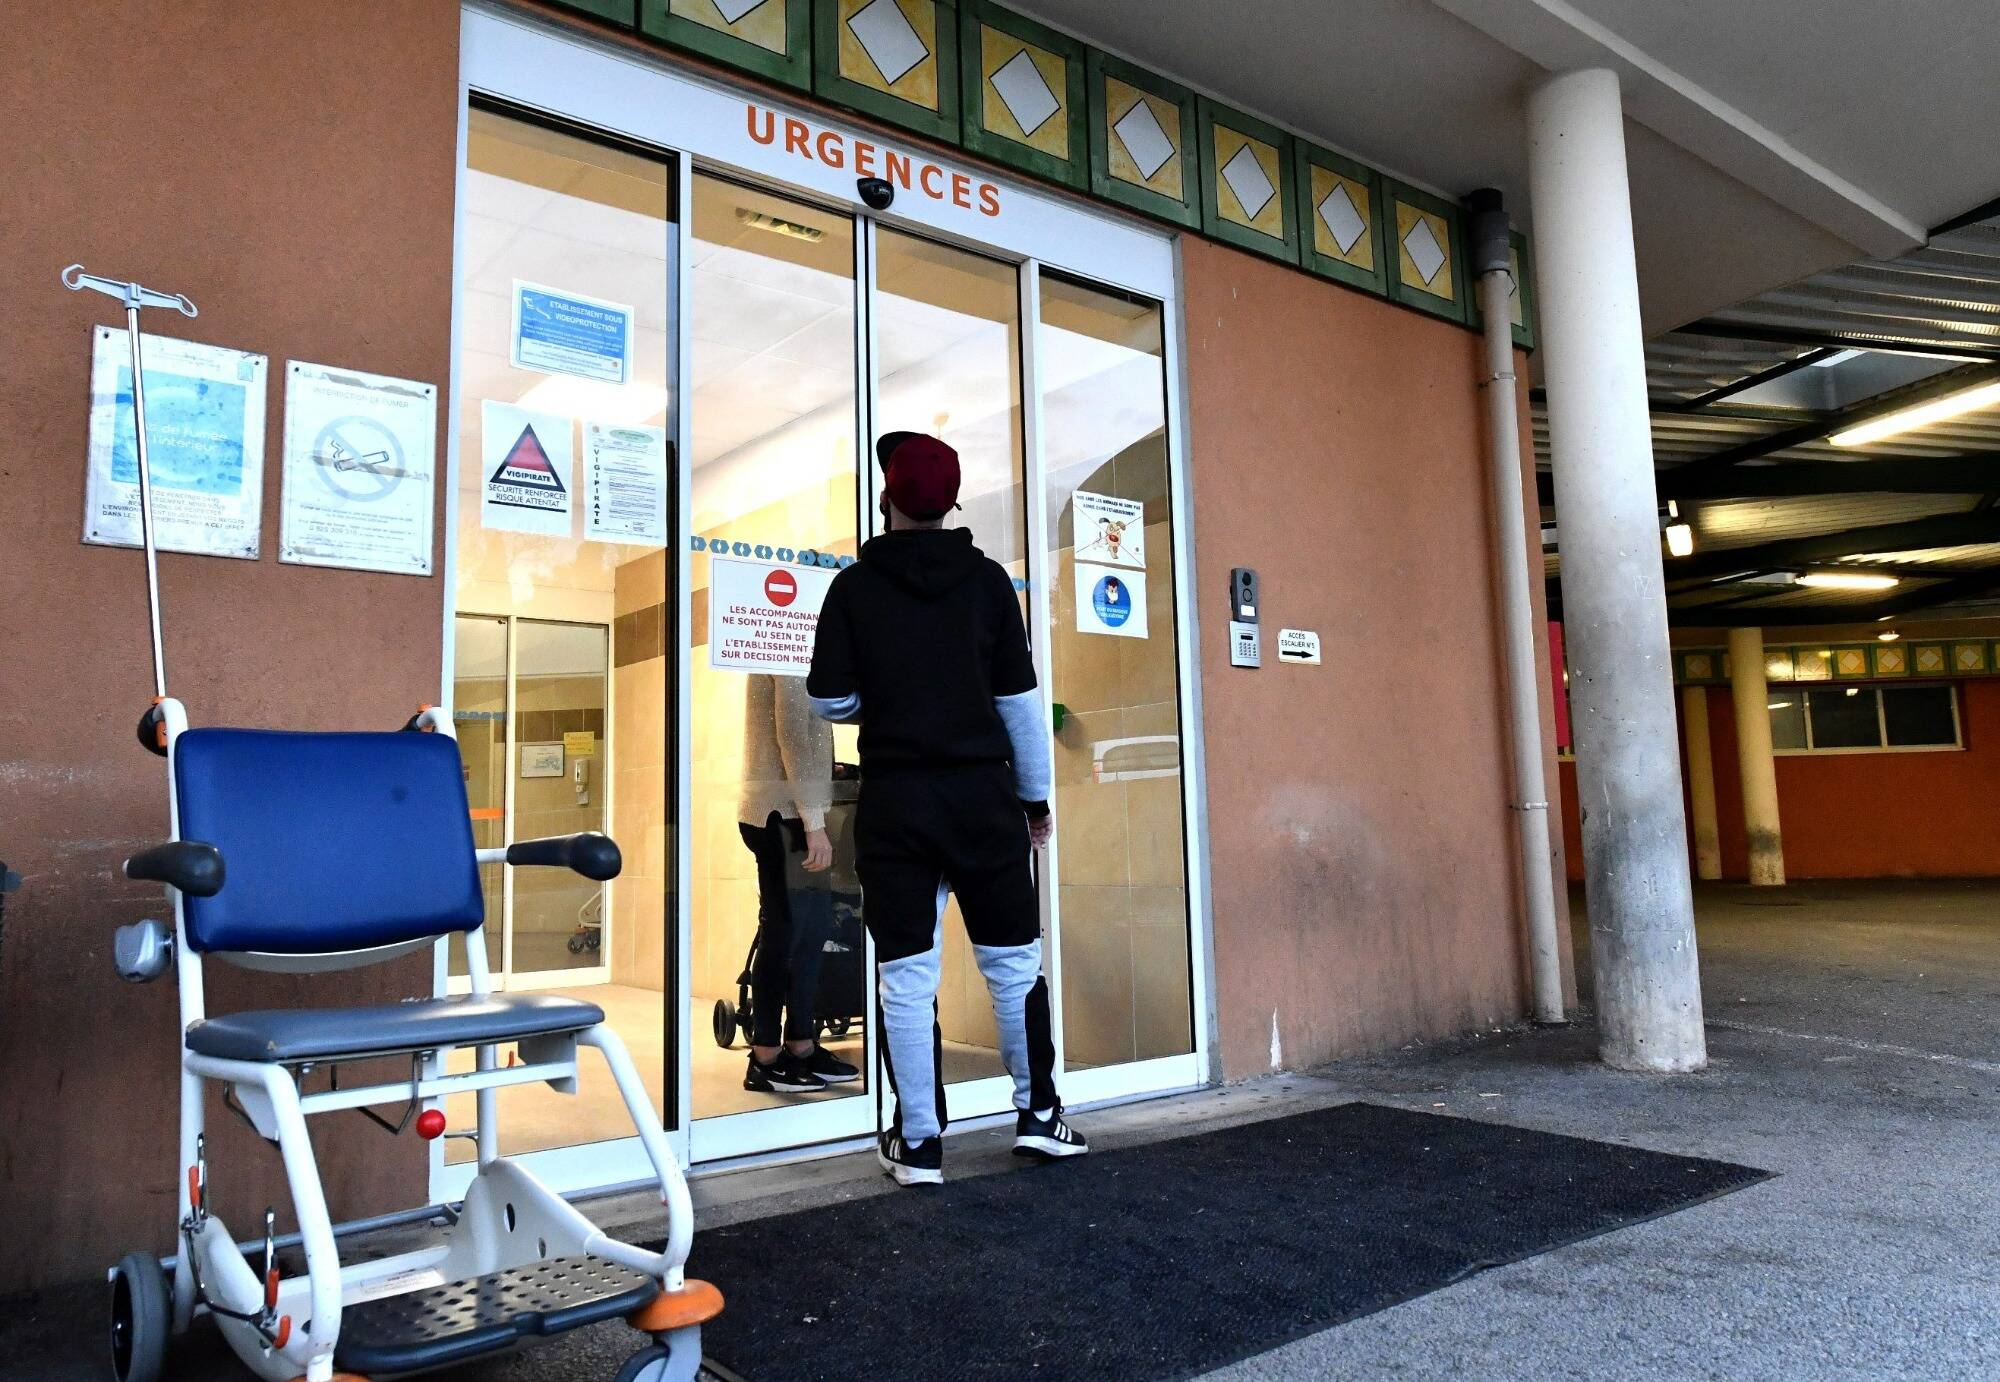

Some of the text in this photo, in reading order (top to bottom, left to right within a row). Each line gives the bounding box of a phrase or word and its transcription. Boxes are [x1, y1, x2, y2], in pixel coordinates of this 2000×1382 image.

[746, 103, 1001, 217] URGENCES
[506, 470, 551, 482] VIGIPIRATE
[488, 483, 523, 494] SECURITE
[593, 448, 601, 525] VIGIPIRATE
[496, 493, 560, 507] RISQUE ATTENTAT
[730, 605, 747, 615] LES
[722, 616, 735, 624] NE
[737, 617, 763, 627] SONT
[766, 620, 784, 629] PAS
[754, 630, 806, 642] AU SEIN DE
[725, 639, 808, 653] L'ETABLISSEMENT
[1281, 639, 1306, 648] ESCALIER
[721, 650, 741, 659] SUR
[744, 652, 790, 662] DECISION
